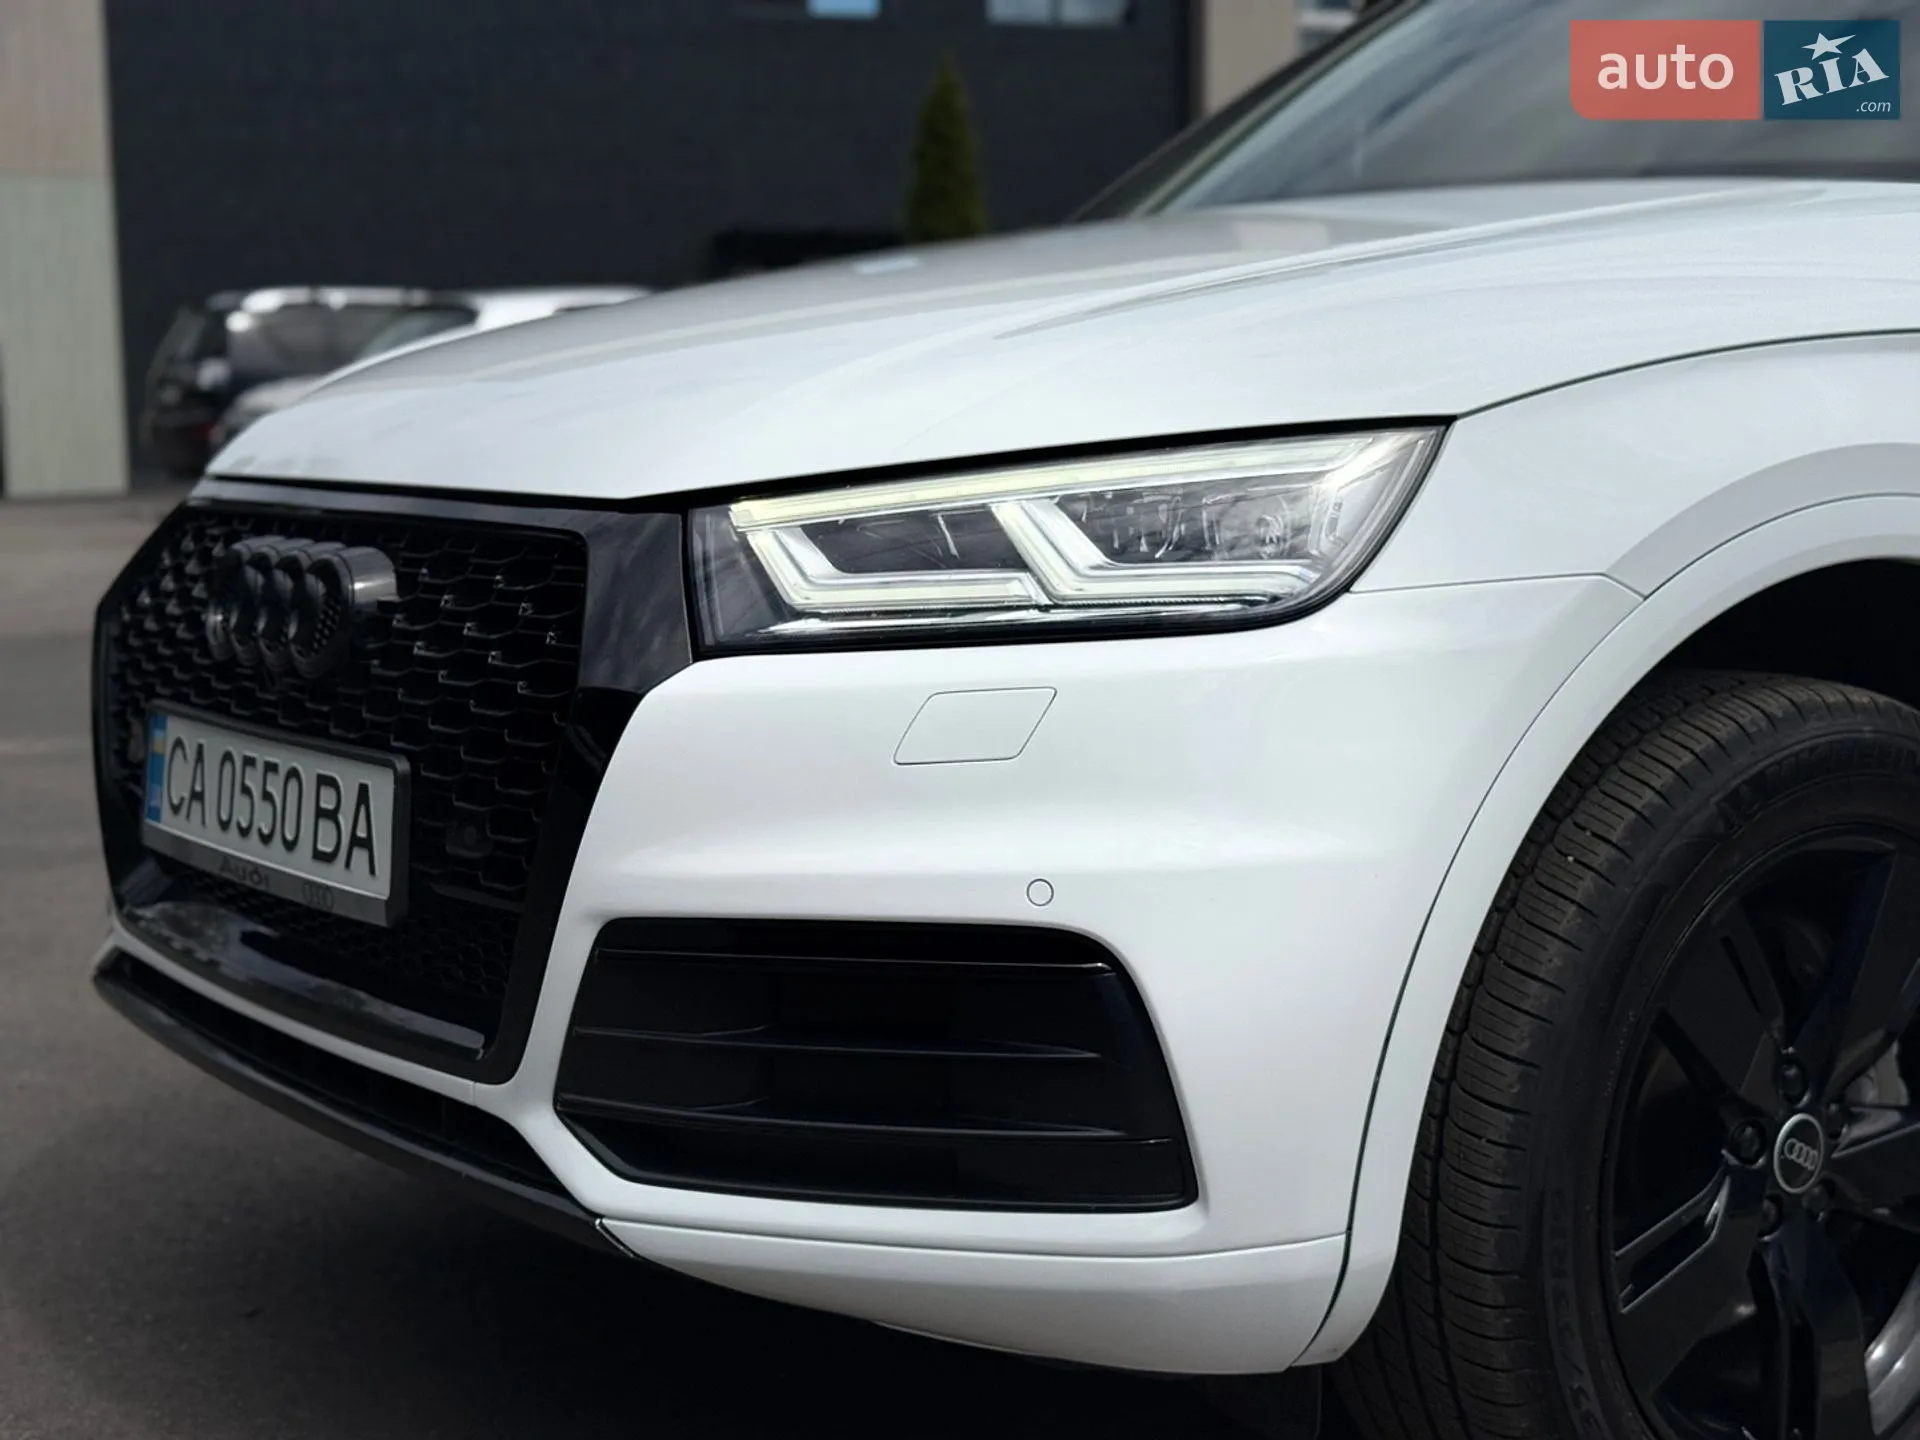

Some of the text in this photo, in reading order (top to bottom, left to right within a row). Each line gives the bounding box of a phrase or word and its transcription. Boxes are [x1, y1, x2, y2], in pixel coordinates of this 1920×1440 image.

[166, 736, 377, 878] CA 0550 BA
